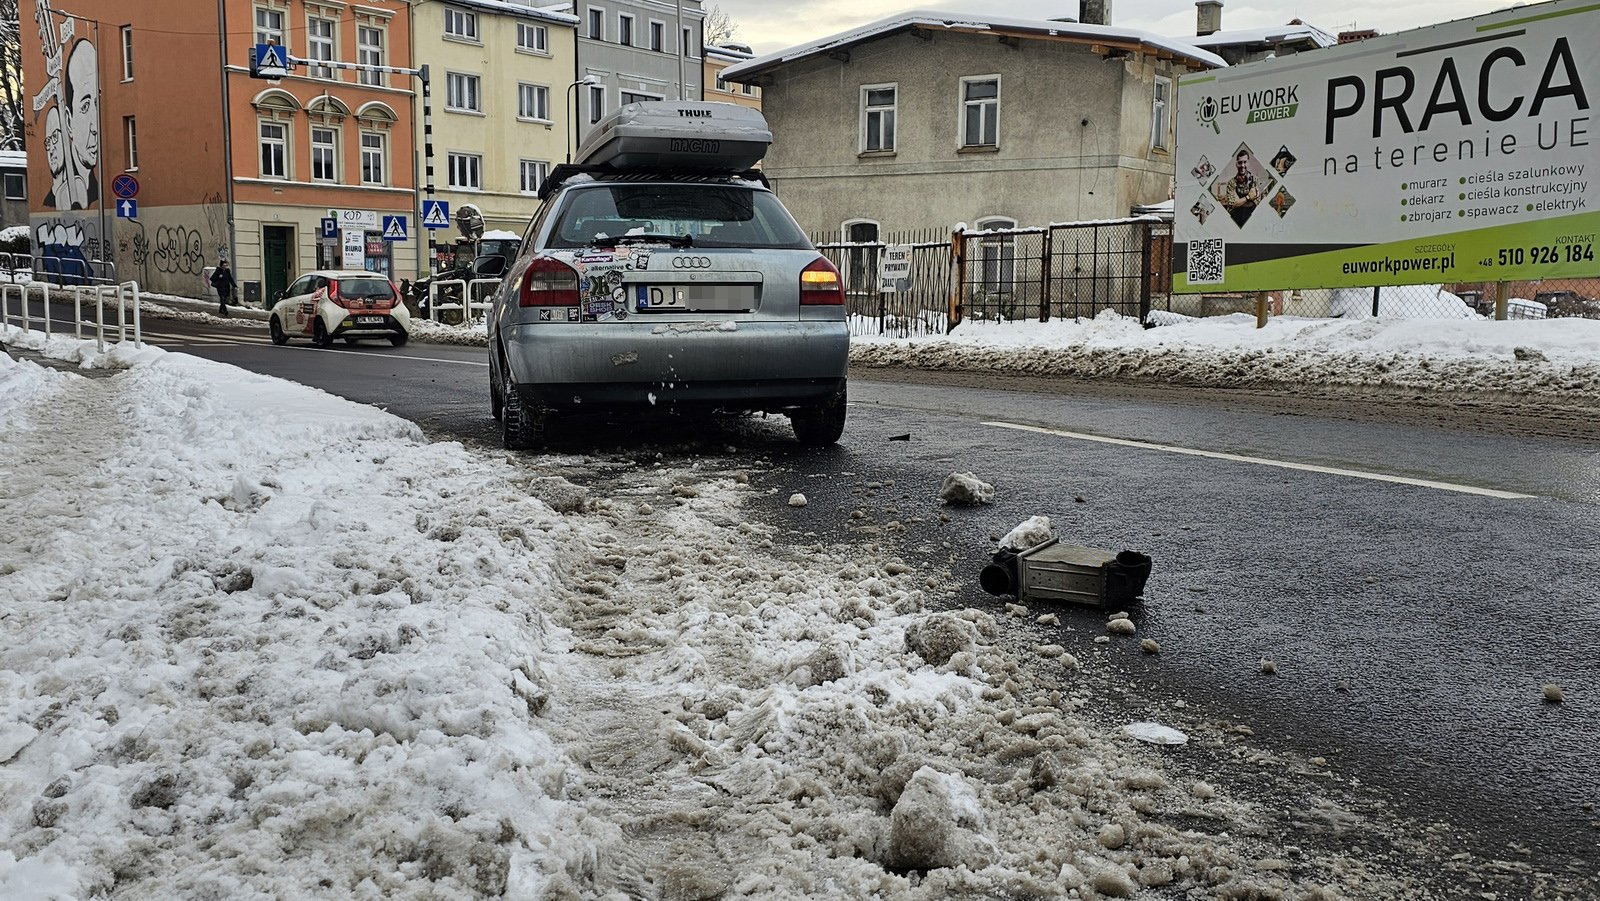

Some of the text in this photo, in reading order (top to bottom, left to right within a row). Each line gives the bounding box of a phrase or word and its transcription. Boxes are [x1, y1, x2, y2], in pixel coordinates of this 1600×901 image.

[1325, 36, 1590, 144] PRACA
[1220, 84, 1299, 115] EU WORK
[677, 109, 713, 118] THULE
[1253, 106, 1290, 122] POWER
[670, 138, 720, 154] mcm
[1324, 116, 1590, 176] na terenie UE
[1467, 164, 1585, 185] cieśla szalunkowy
[1409, 177, 1448, 190] murarz
[1467, 180, 1588, 201] cieśla konstrukcyjny
[1409, 193, 1445, 206] dekarz
[1535, 196, 1587, 212] elektryk
[1408, 209, 1452, 223] zbrojarz
[1467, 203, 1519, 219] spawacz
[325, 220, 334, 235] P
[1555, 233, 1597, 245] KONTAKT
[889, 251, 905, 260] TEREN
[1414, 243, 1457, 254] SZCZEGÓŁY
[1478, 243, 1594, 267] +48 510 926 184
[1342, 252, 1456, 275] euworkpower.pl
